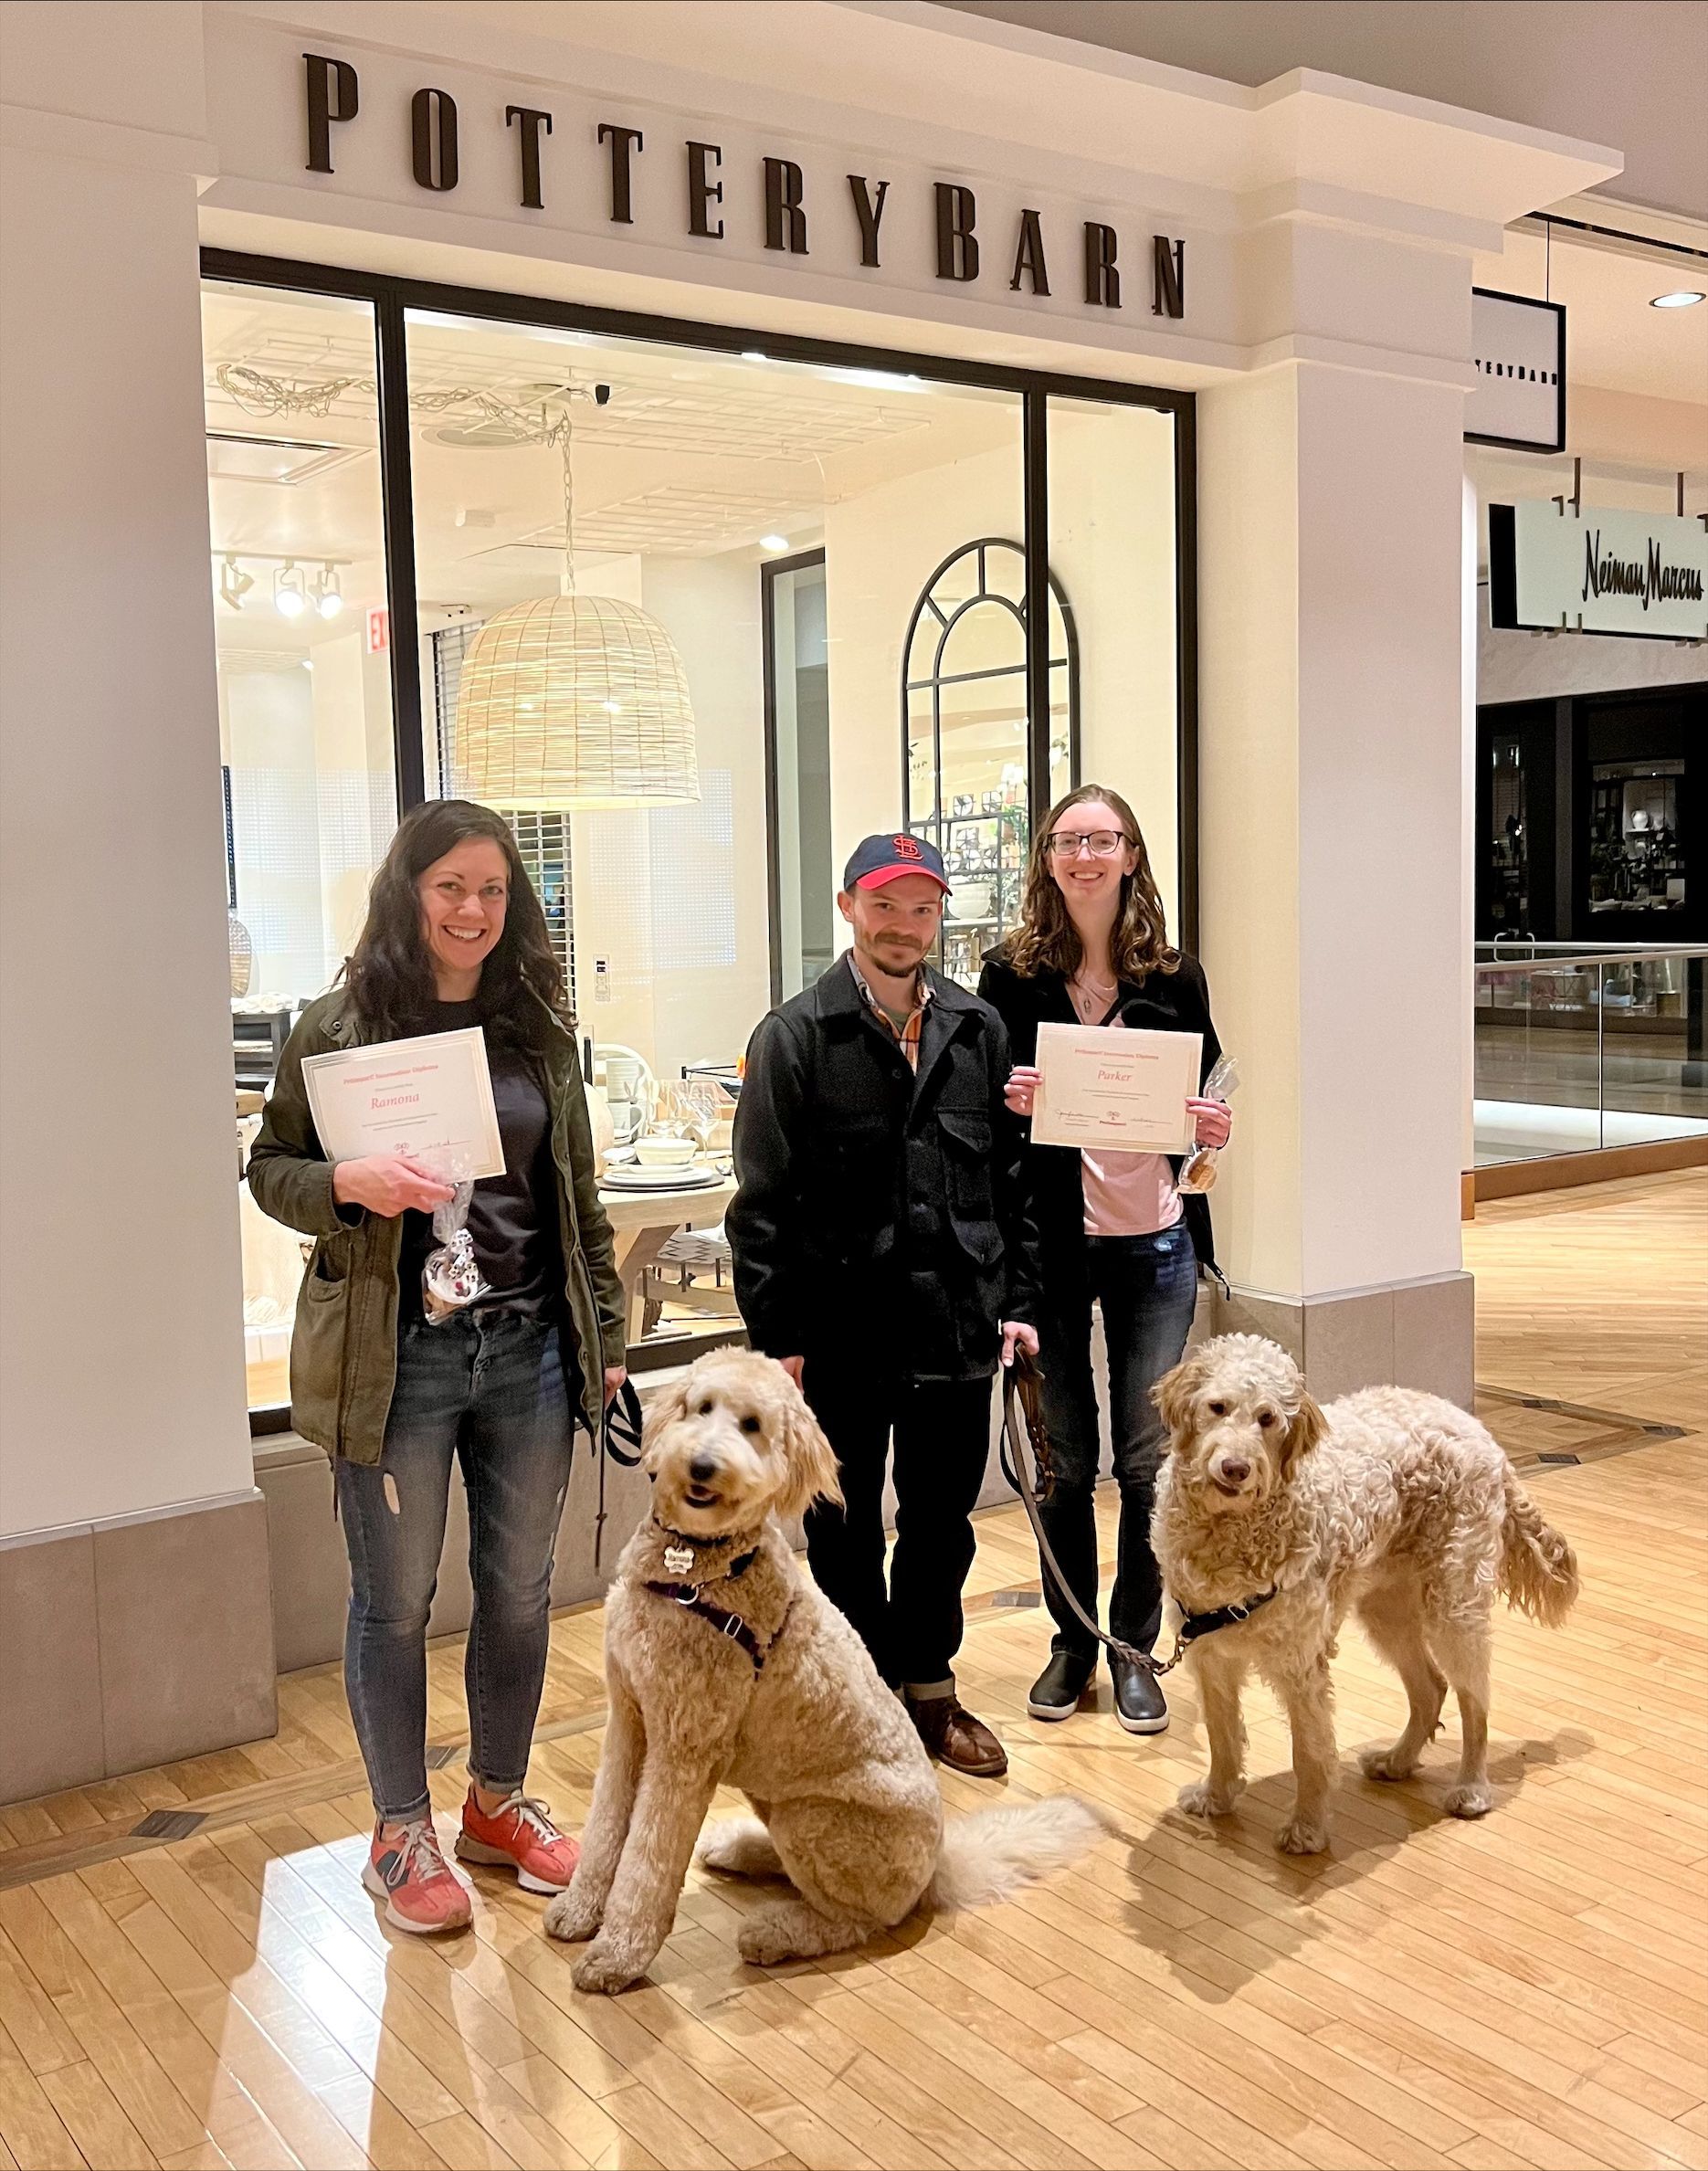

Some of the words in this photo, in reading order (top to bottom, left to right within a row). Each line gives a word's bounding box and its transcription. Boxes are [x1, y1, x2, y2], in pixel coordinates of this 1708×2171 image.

[1582, 529, 1645, 602] Neiman
[1642, 536, 1704, 611] Marcus
[1098, 1070, 1132, 1081] Parker
[371, 1093, 419, 1110] Ramona
